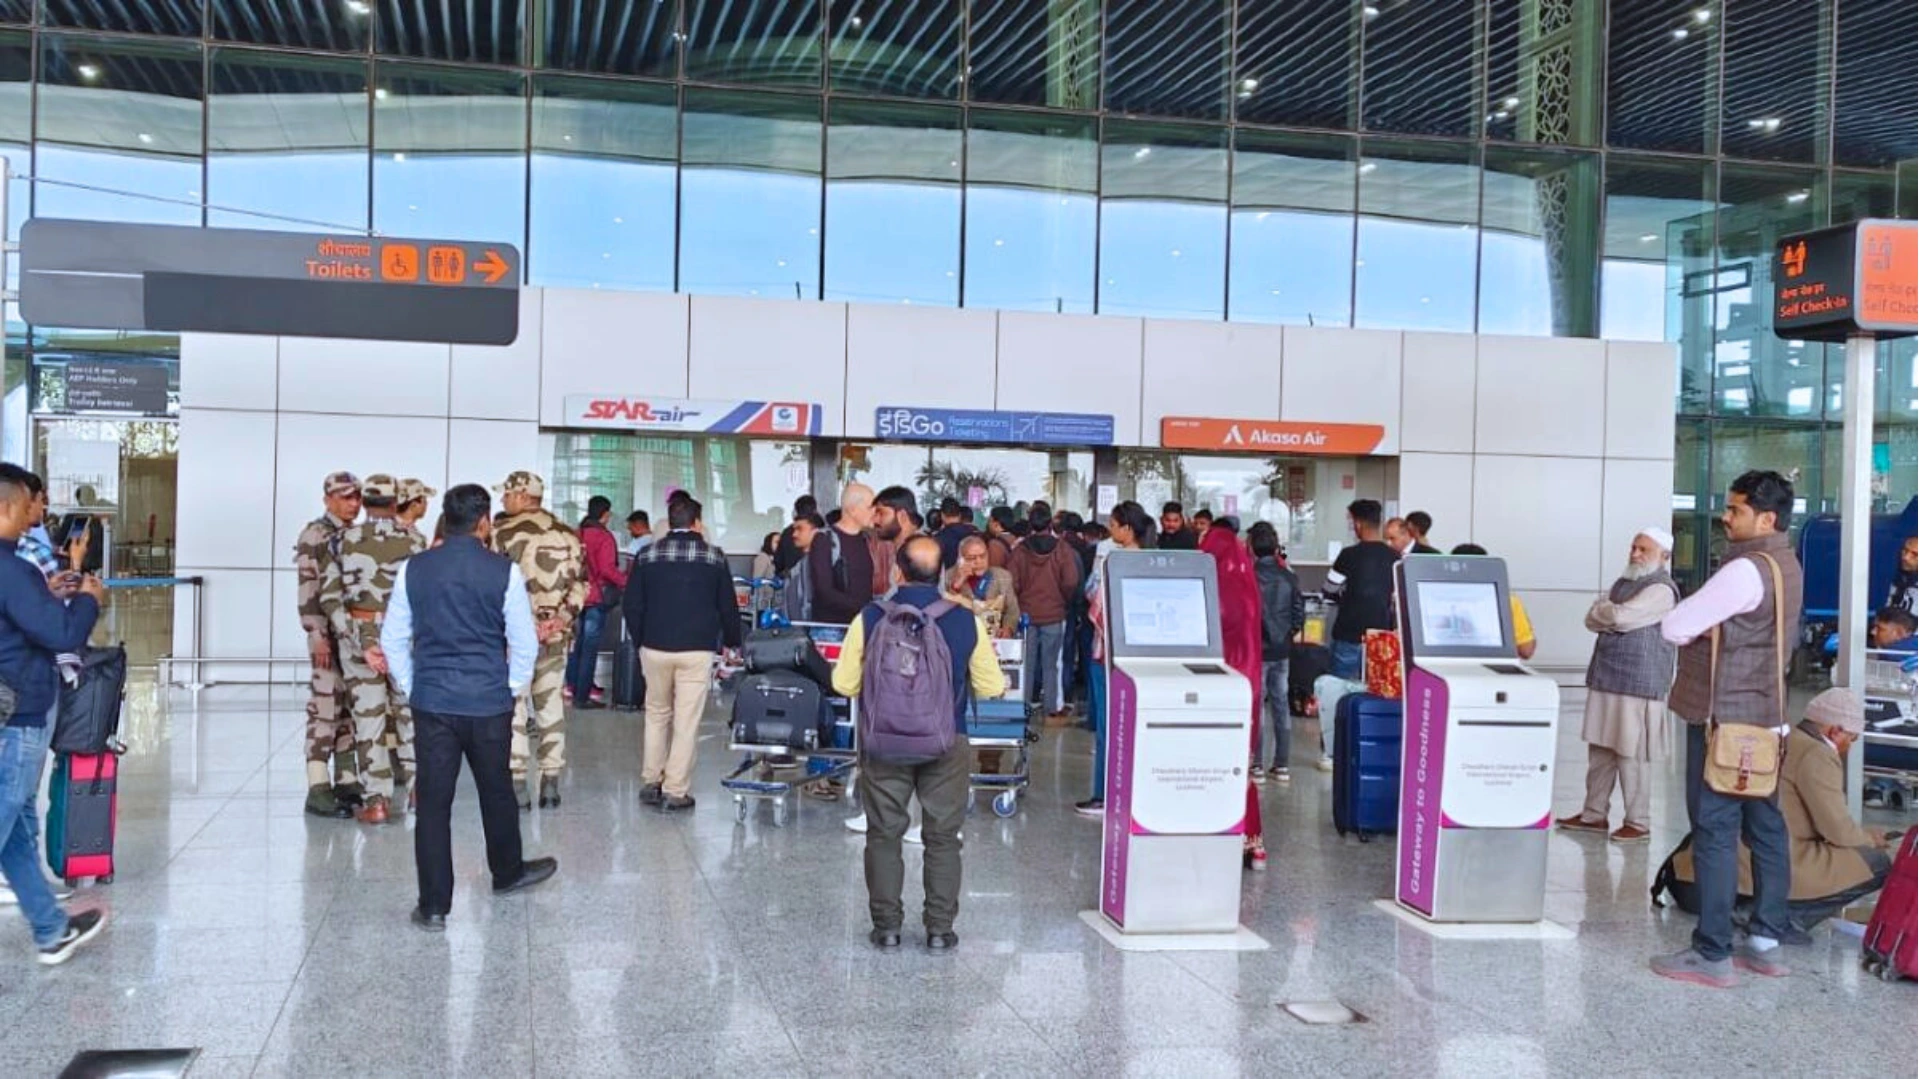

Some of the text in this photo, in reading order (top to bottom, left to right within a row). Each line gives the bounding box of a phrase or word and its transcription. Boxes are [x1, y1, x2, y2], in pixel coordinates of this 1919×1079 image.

[306, 260, 372, 279] Toilets
[1780, 301, 1799, 317] Self
[582, 399, 656, 421] STAR
[1250, 429, 1328, 446] Akasa Air
[1114, 689, 1127, 790] Goodness
[1410, 688, 1432, 894] Gateway to Goodness
[1109, 819, 1123, 904] Gateway
